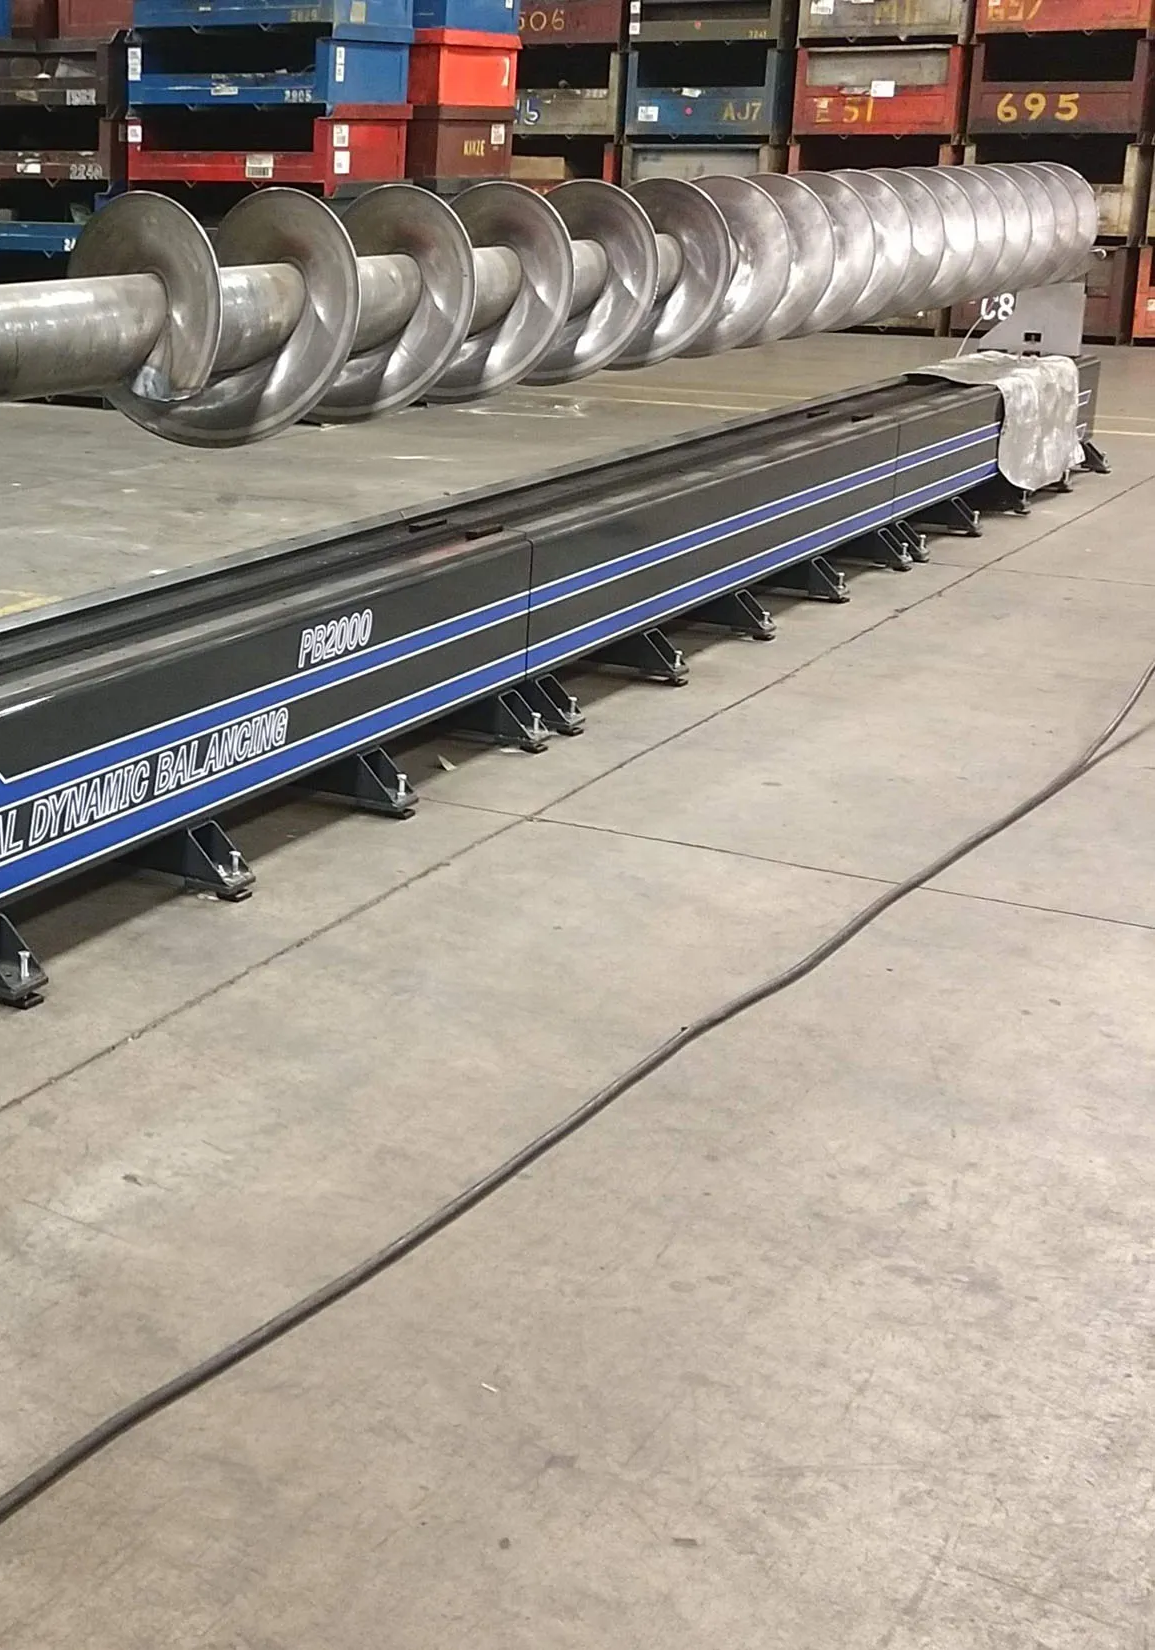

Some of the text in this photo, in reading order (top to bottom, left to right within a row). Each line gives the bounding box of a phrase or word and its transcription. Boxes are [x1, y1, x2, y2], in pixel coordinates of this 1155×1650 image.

[996, 92, 1080, 122] 695
[297, 607, 374, 669] PB2000
[28, 760, 151, 847] DYNAMIC
[153, 706, 289, 796] BALANCING
